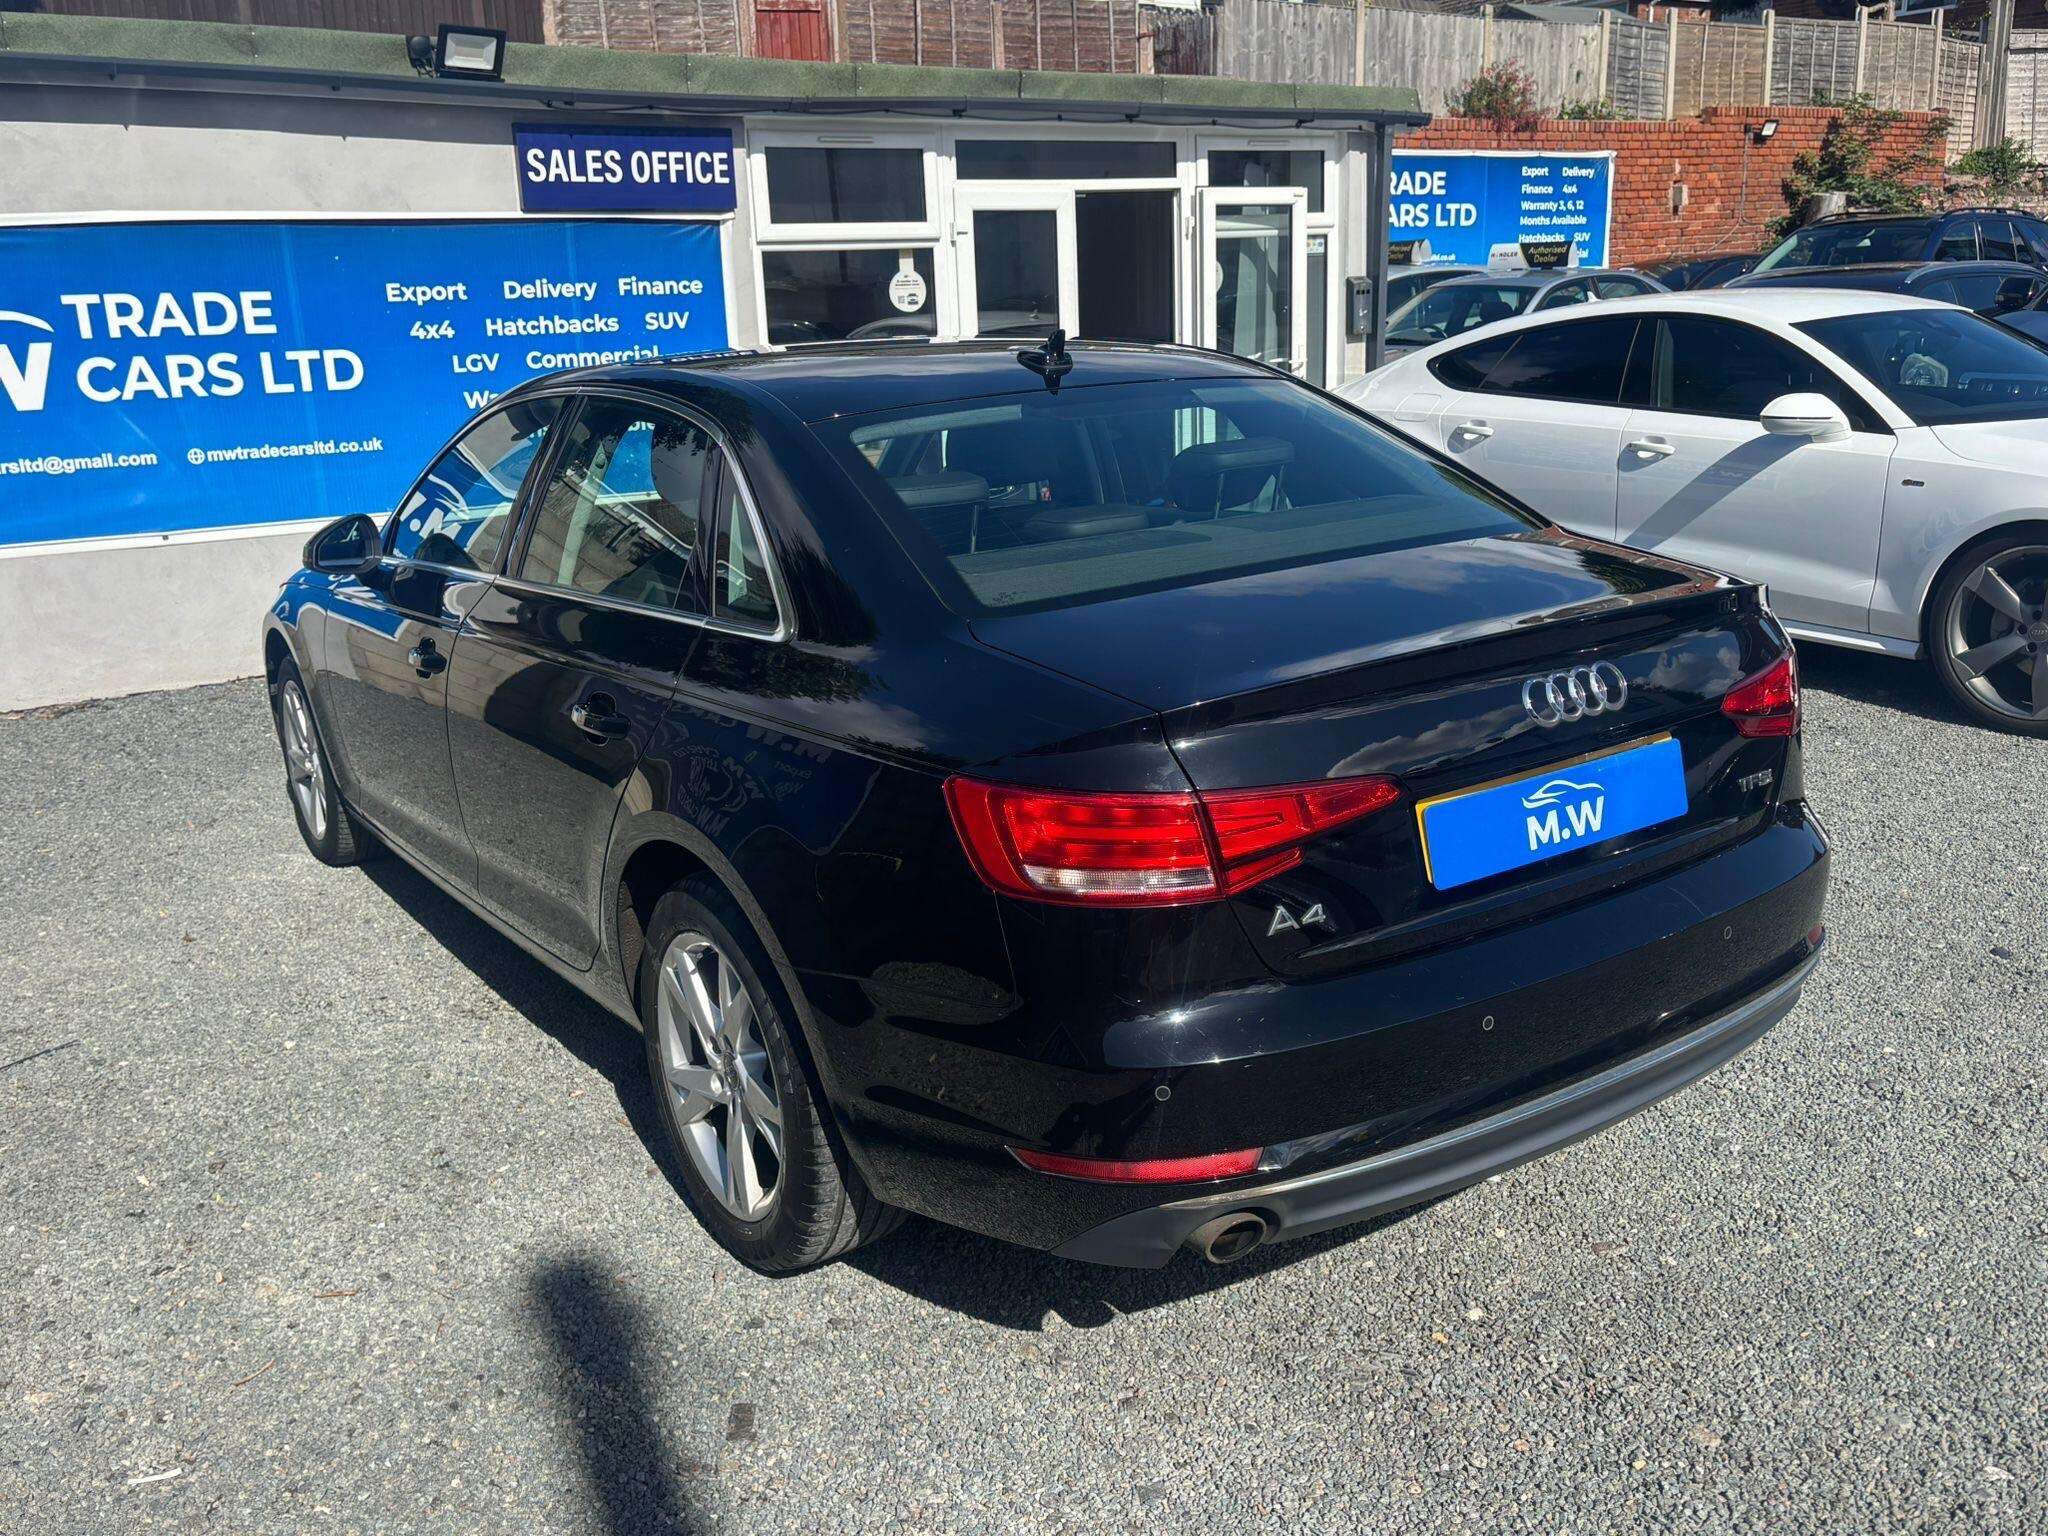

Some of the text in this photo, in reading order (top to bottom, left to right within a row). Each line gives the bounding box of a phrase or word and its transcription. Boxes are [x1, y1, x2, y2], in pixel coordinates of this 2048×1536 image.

[527, 148, 730, 184] SALES OFFICE
[1522, 166, 1595, 178] Export Delivery
[1521, 184, 1578, 194] Finance 4x4
[1435, 203, 1477, 227] LTD
[1520, 201, 1558, 212] Warranty
[1576, 200, 1585, 210] 12
[1519, 214, 1587, 226] Months Available
[1518, 232, 1591, 244] Hatchbacks SUV
[1528, 245, 1568, 255] Authorised
[1533, 254, 1559, 264] Dealer
[385, 277, 703, 306] Export Delivery Finance
[60, 291, 278, 339] TRADE
[410, 311, 689, 340] 4x4 Hatchbacks SUV
[452, 353, 499, 374] LGV
[76, 349, 364, 403] CARS LTD
[207, 437, 384, 464] mwtradecarsltd.co.uk
[0, 453, 157, 476] rsltd@gmail.com
[1526, 795, 1605, 851] M.W
[1267, 903, 1327, 937] A4
